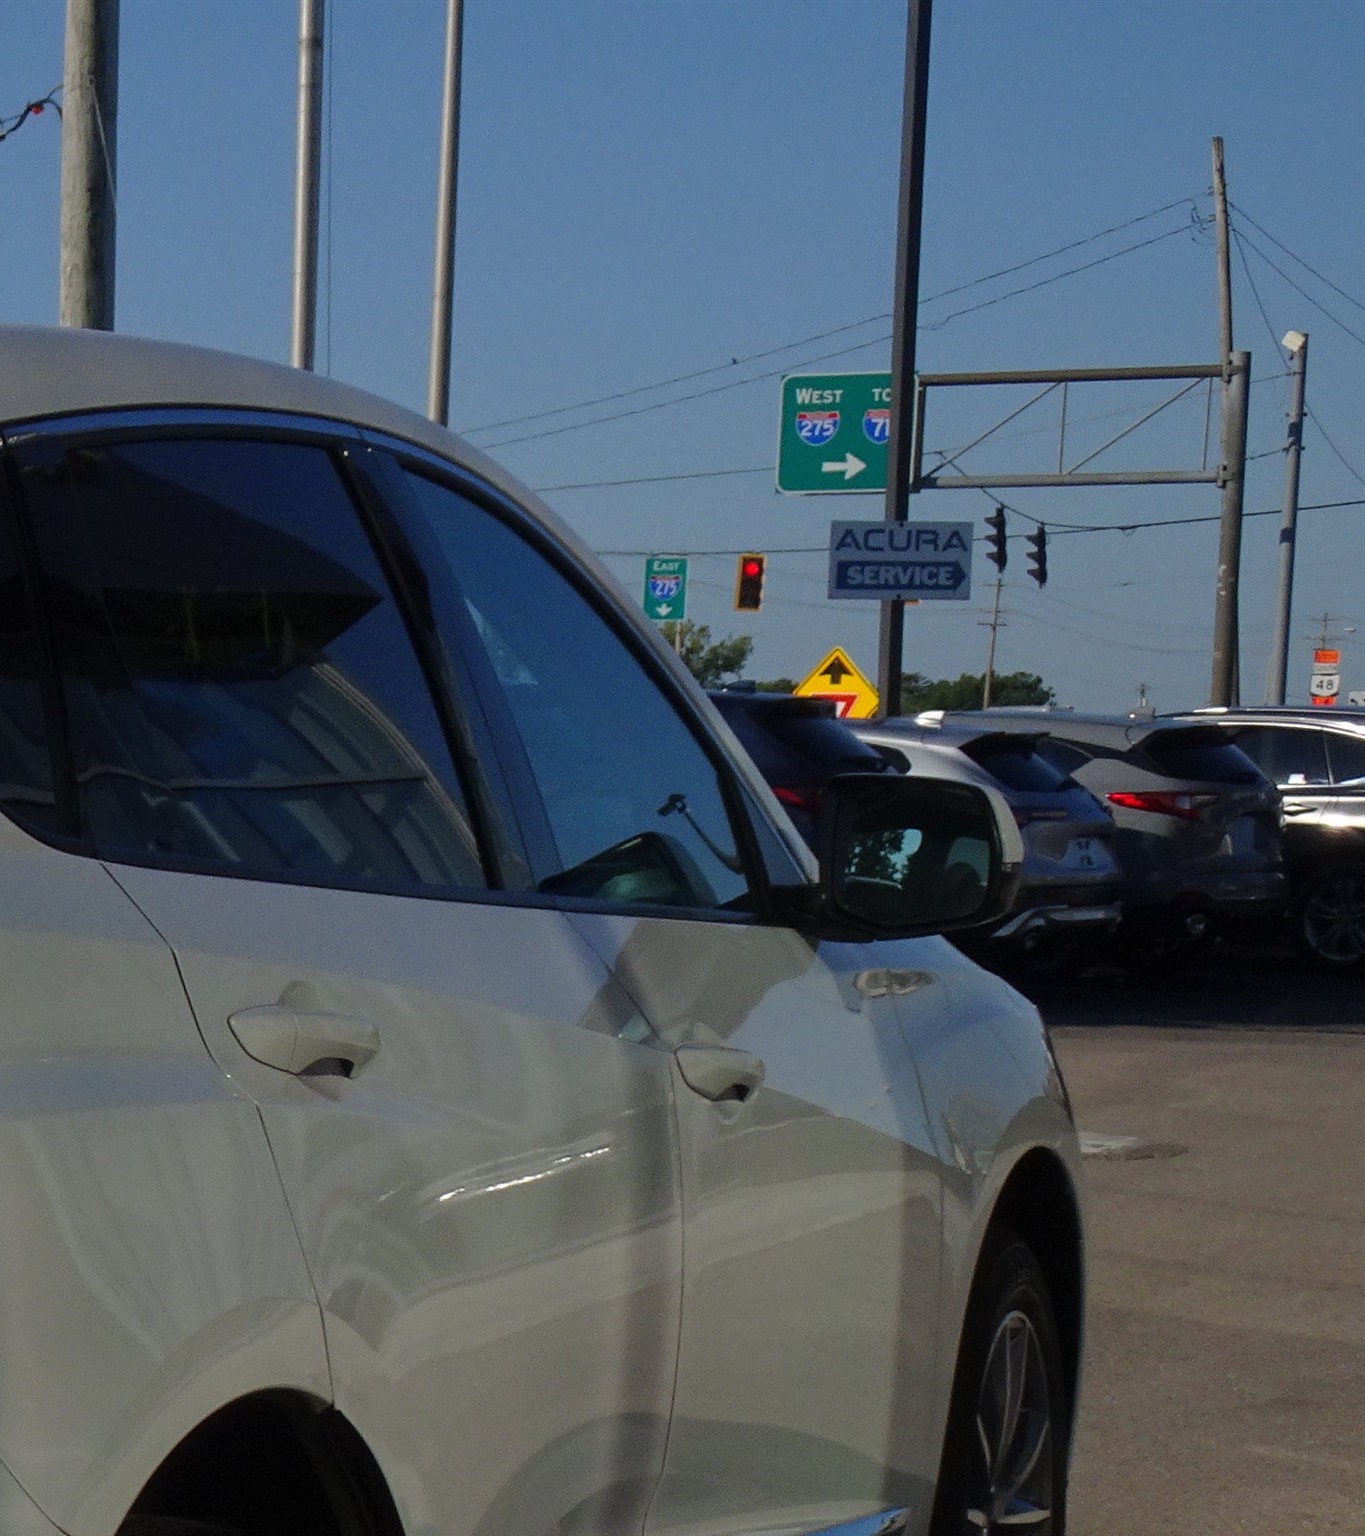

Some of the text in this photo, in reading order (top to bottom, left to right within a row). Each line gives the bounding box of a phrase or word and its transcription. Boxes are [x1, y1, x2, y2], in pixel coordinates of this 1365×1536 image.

[796, 387, 843, 405] WEST
[800, 419, 835, 437] 275
[835, 528, 968, 552] ACURA
[653, 561, 680, 571] EAST
[847, 565, 954, 585] SERVICE
[655, 581, 678, 596] 275
[1316, 680, 1334, 690] 48
